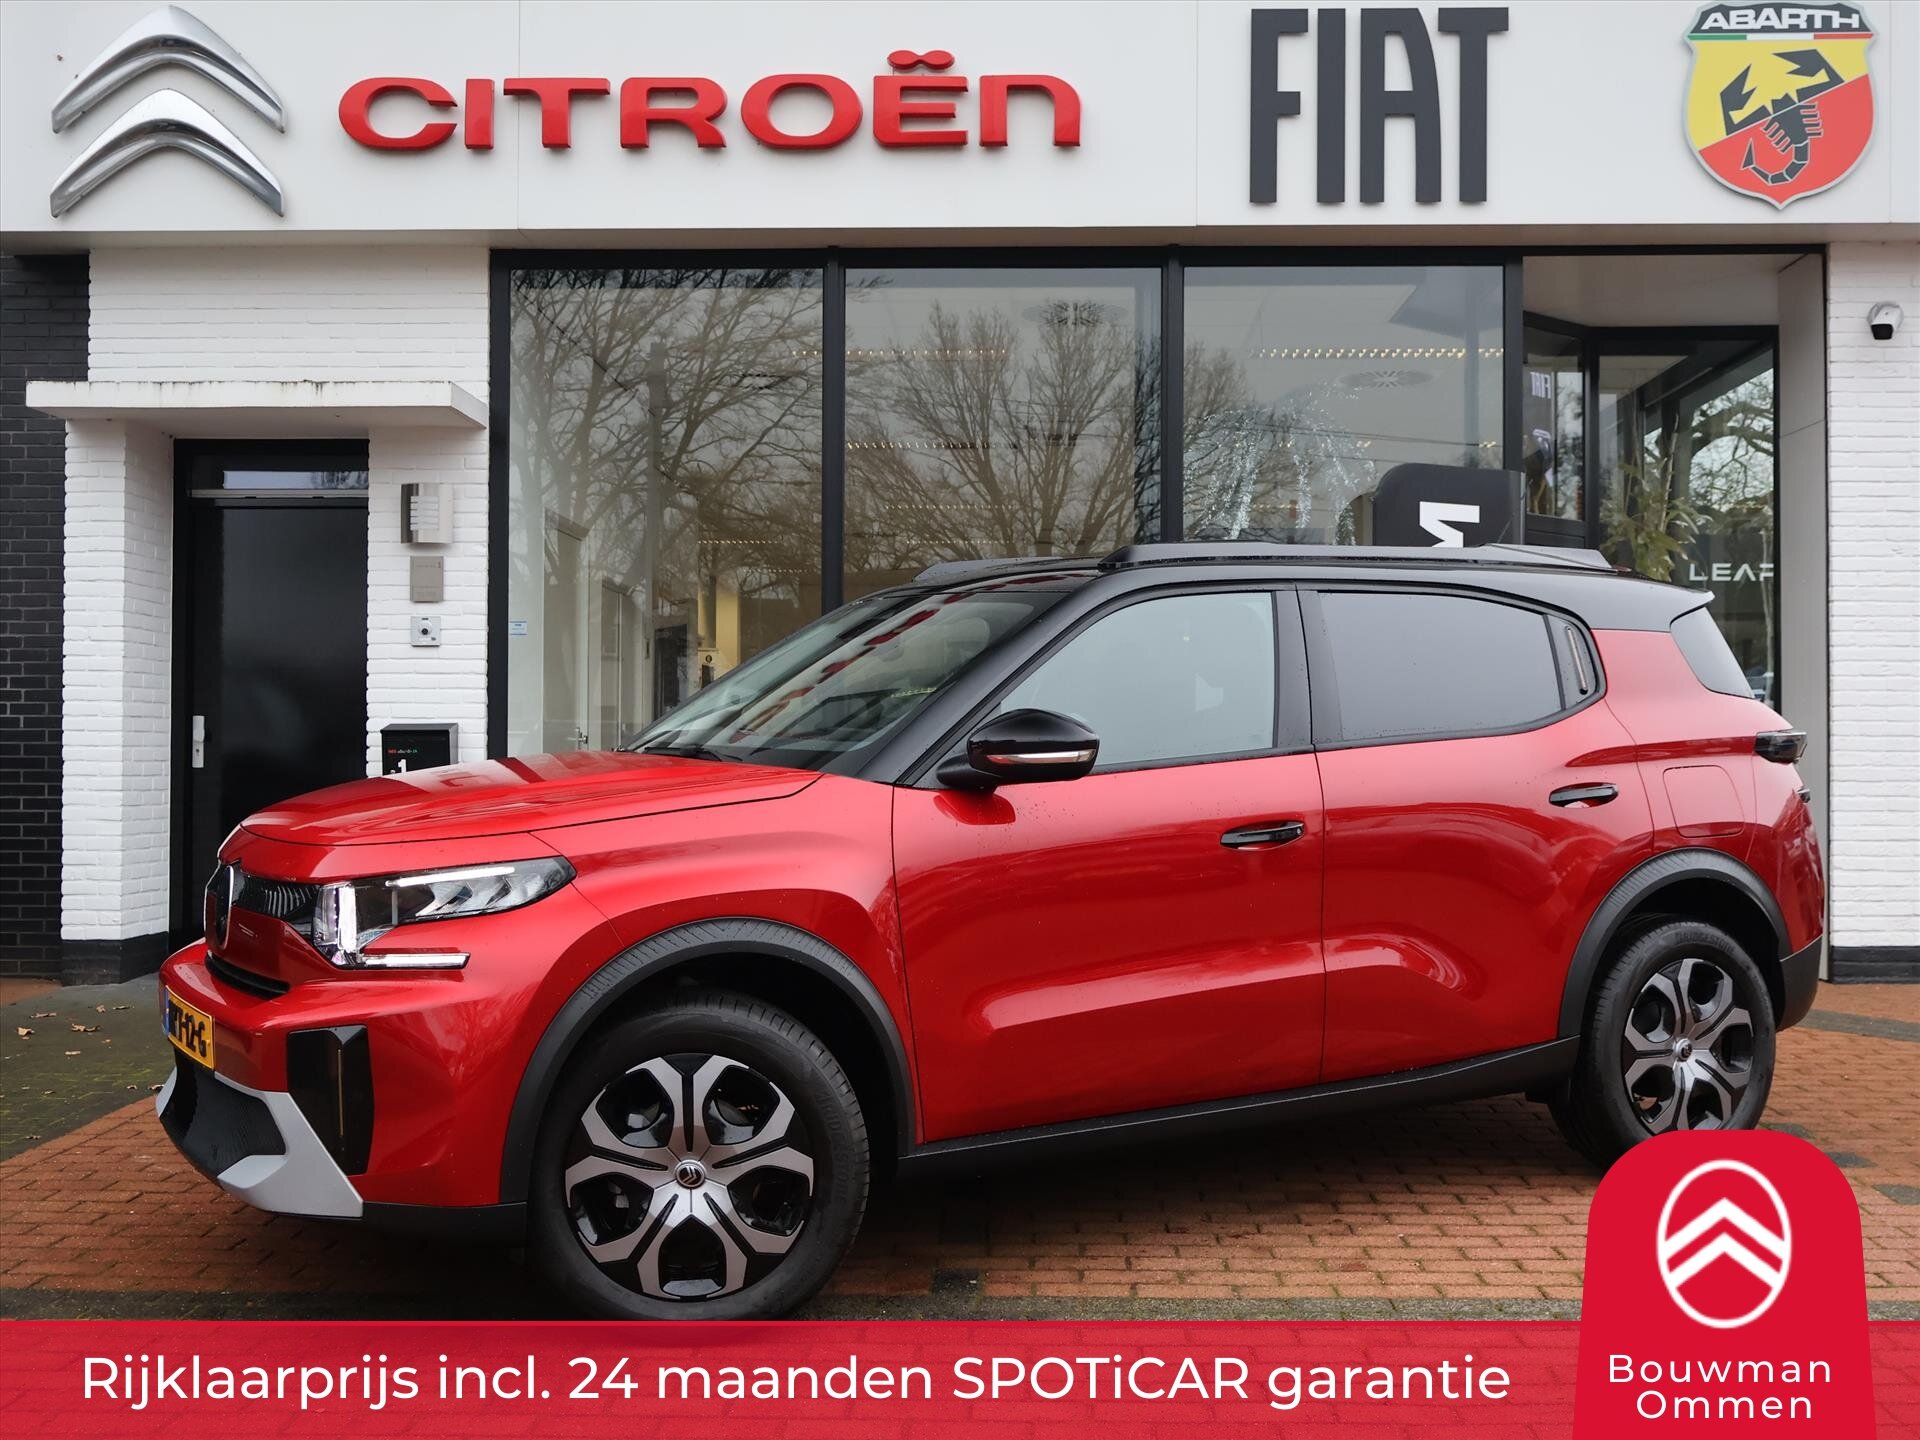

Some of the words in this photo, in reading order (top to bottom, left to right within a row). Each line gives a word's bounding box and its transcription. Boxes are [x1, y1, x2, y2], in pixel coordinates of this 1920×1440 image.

[1701, 7, 1859, 30] ABARTH
[339, 50, 1082, 150] CITROËN
[1250, 8, 1508, 205] FIAT
